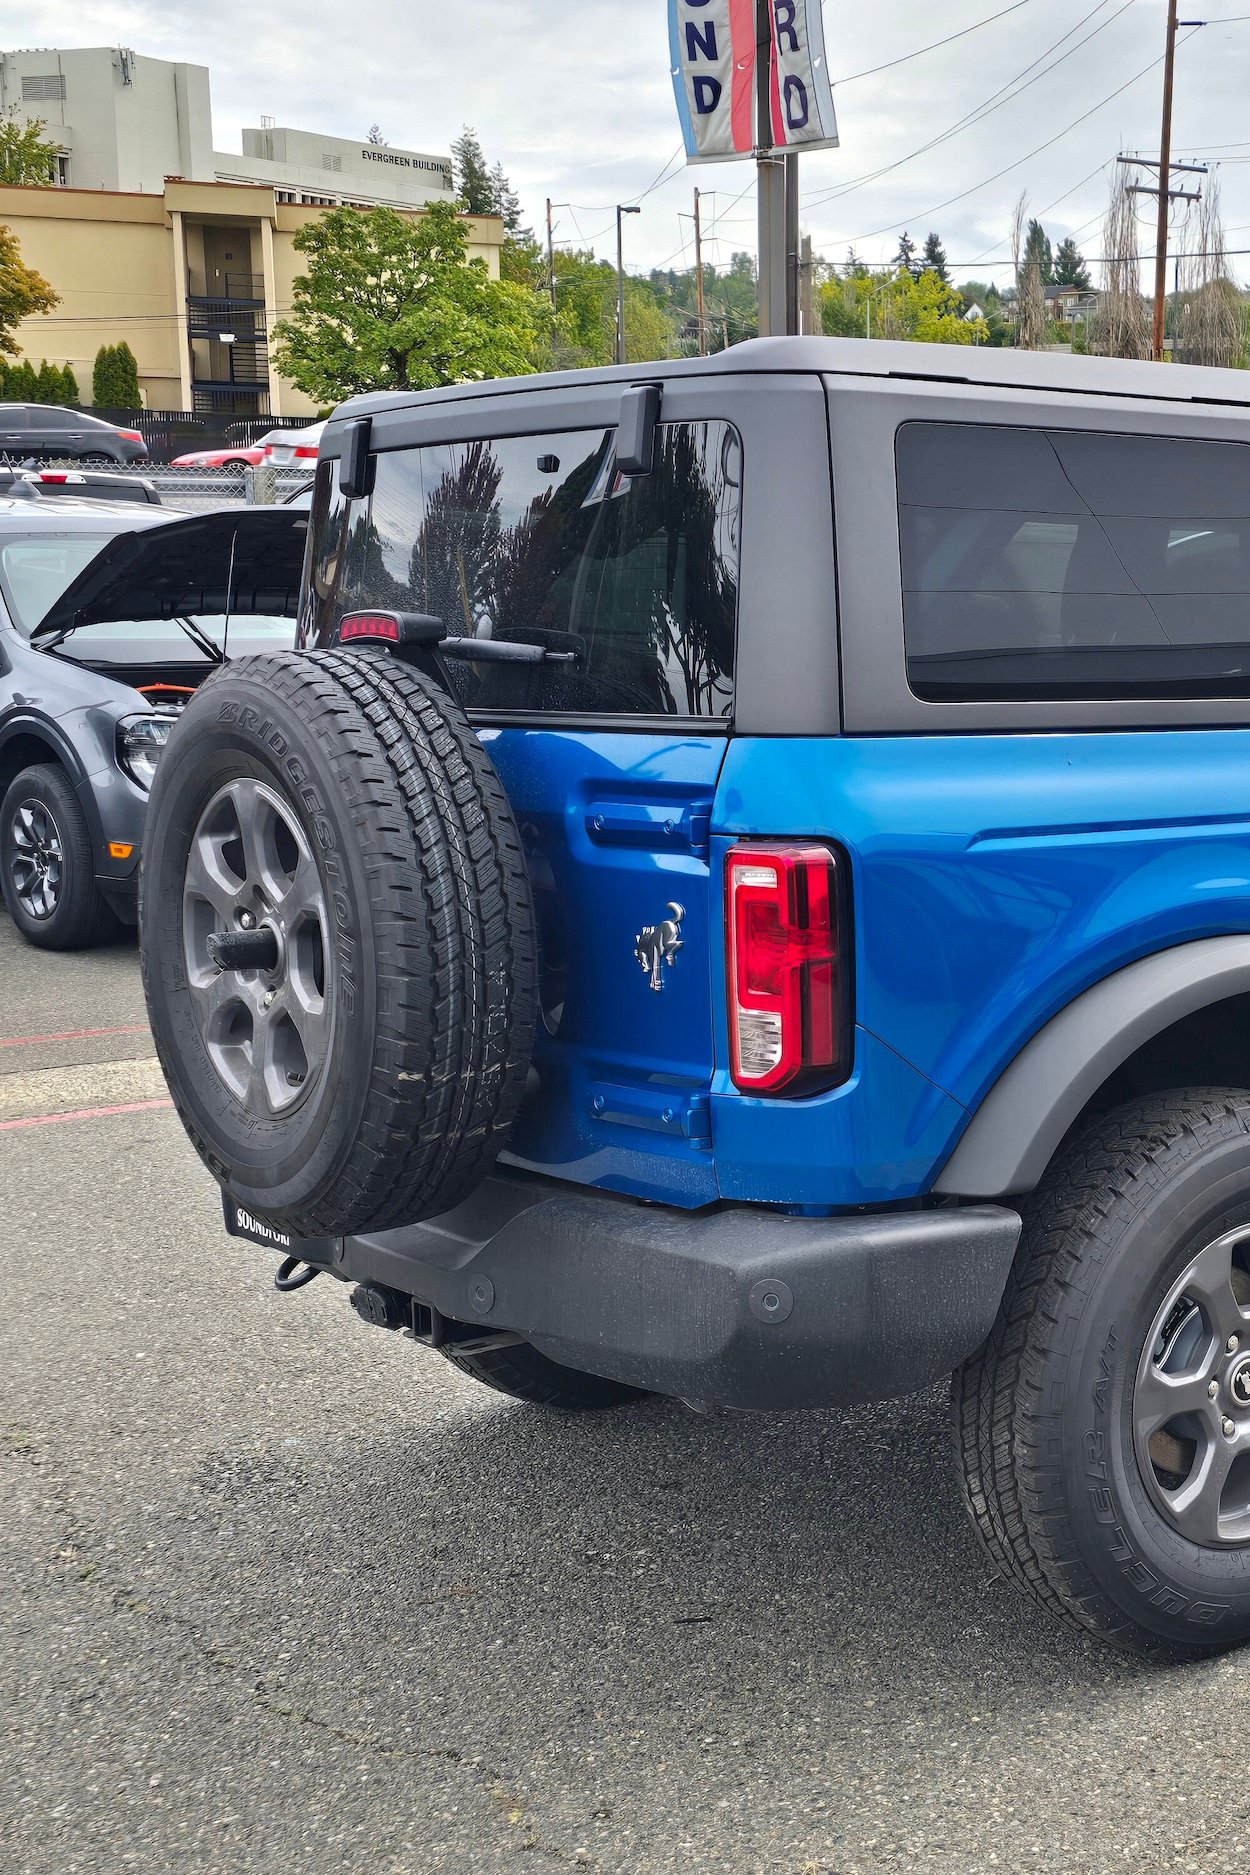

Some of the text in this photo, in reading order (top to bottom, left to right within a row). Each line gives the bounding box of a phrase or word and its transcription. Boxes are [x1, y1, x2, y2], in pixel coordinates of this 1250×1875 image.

[362, 150, 450, 174] EVERGREEN BUILDING
[216, 700, 358, 1017] BRIDGESTONE
[1082, 1428, 1232, 1625] DUELER
